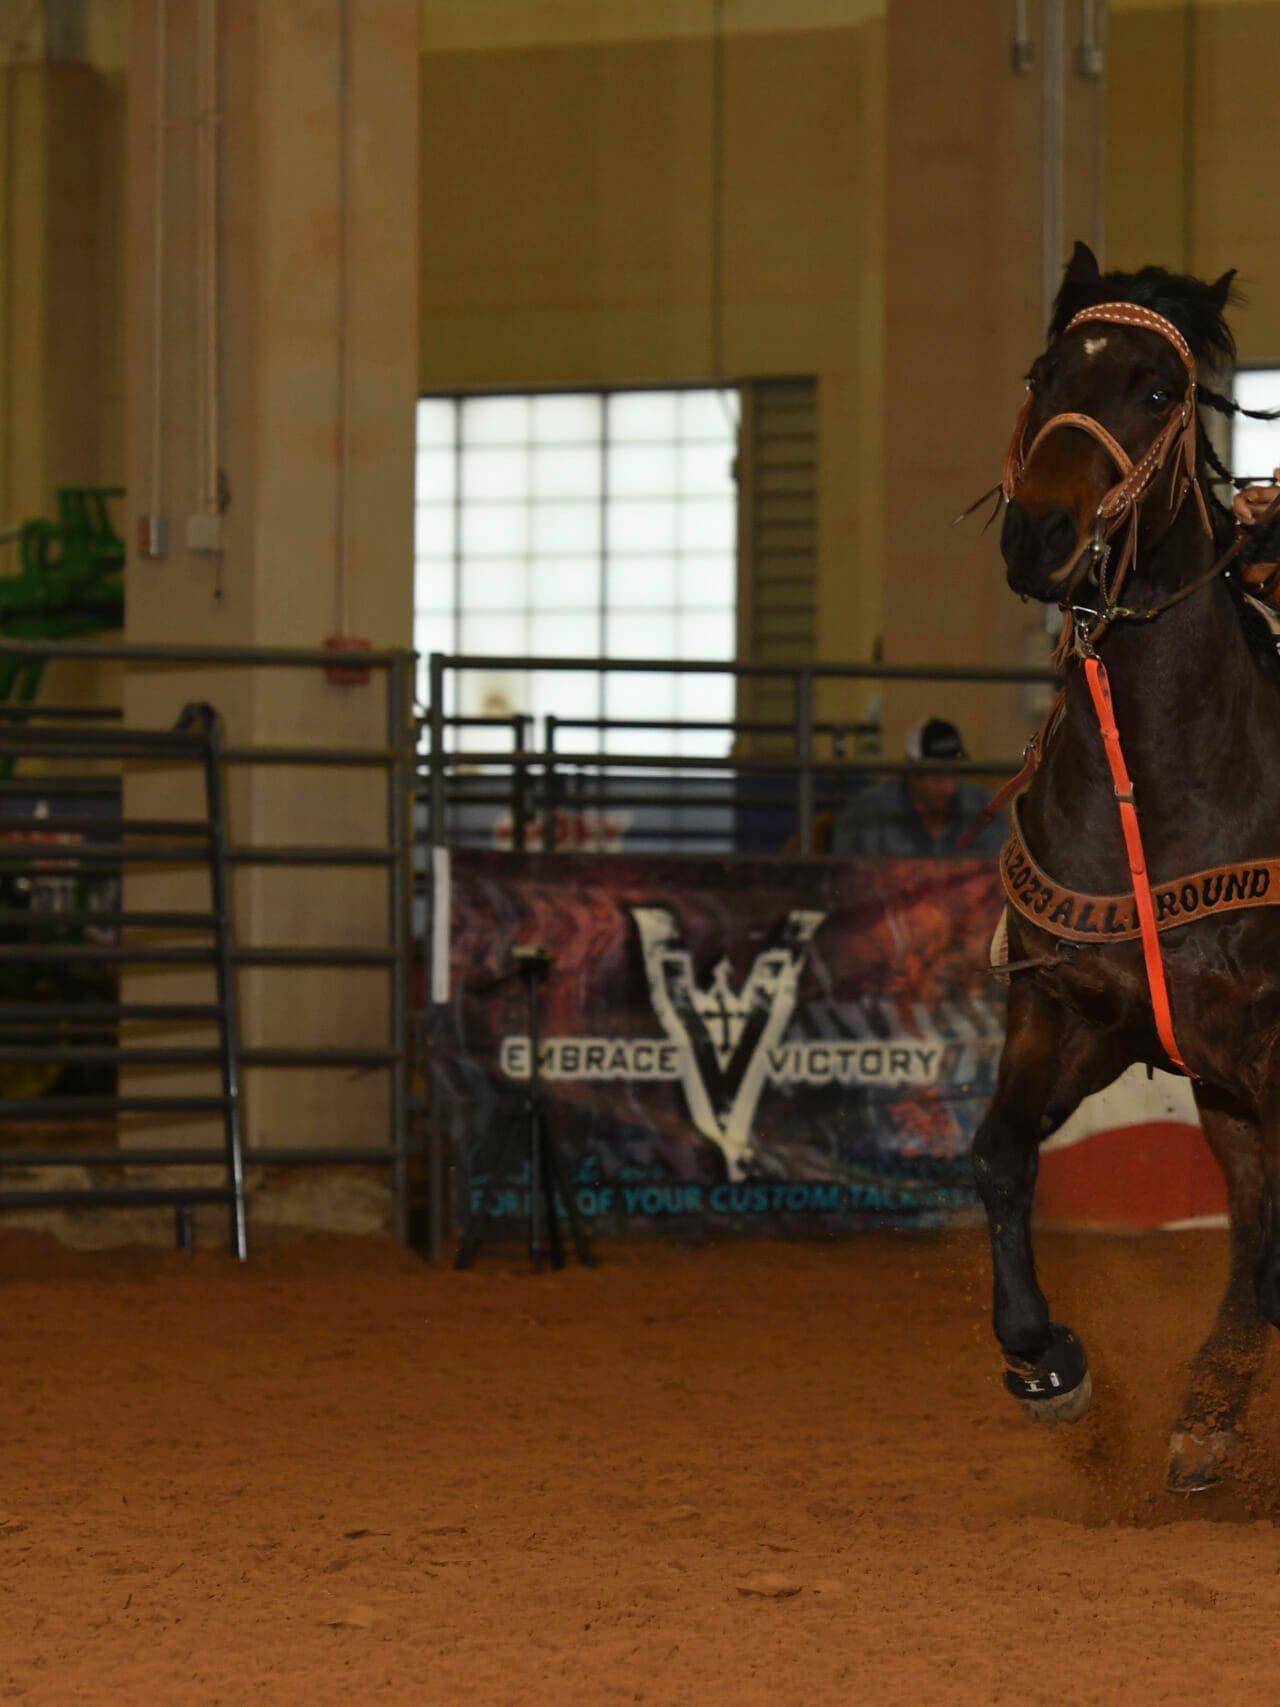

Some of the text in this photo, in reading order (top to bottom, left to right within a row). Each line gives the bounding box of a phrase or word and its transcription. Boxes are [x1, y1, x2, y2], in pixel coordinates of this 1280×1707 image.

[1050, 900, 1126, 935] ALL
[1133, 867, 1272, 930] ROUND
[506, 1043, 939, 1078] EMBRACE VICTORY
[623, 1183, 703, 1215] YOUR
[709, 1182, 840, 1213] CUSTOM
